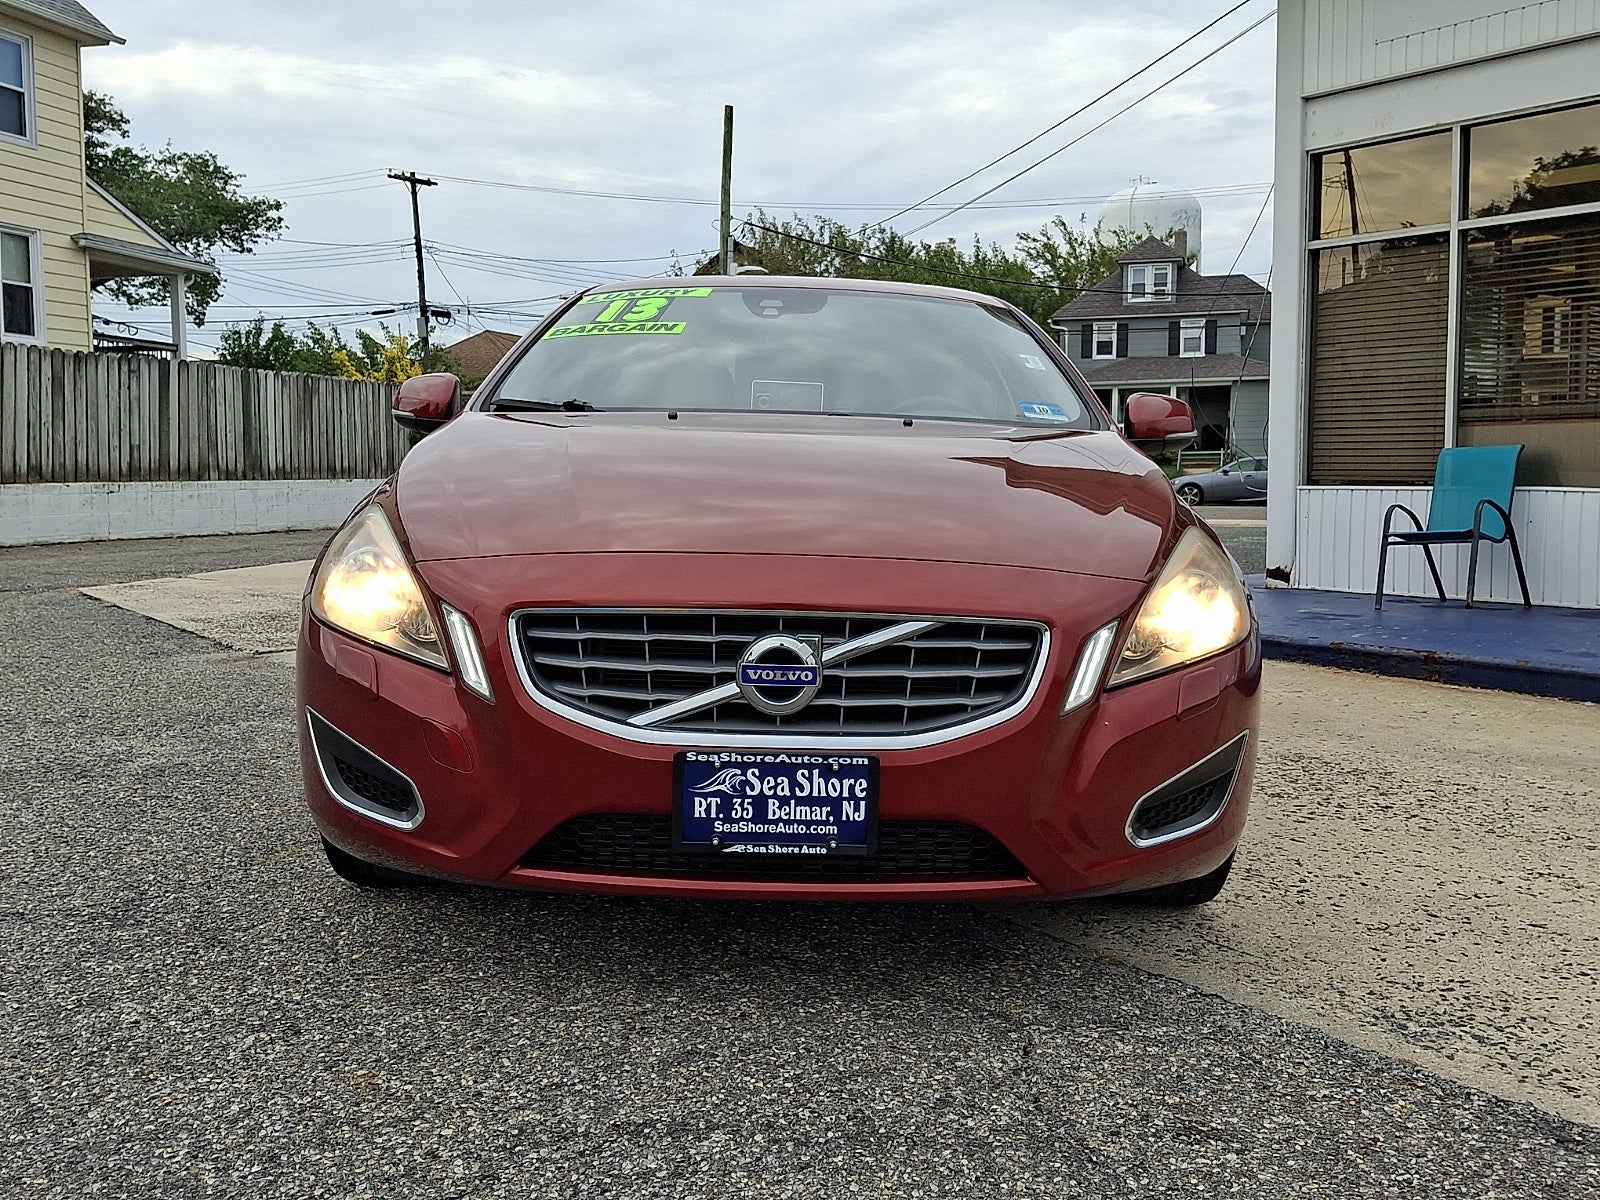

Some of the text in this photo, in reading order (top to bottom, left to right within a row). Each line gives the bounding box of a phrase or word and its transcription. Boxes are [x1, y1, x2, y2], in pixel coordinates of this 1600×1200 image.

[587, 289, 695, 302] LUXURY
[594, 297, 669, 322] 13
[552, 323, 678, 336] BARGAIN
[746, 669, 813, 682] VOLVO
[686, 752, 869, 765] SeaShoreAuto.com
[745, 768, 868, 797] Sea Shore
[693, 797, 866, 822] RT. 35 Belmar, NJ
[714, 821, 838, 835] SeaShoreAuto.com
[746, 845, 827, 854] Sea Shore Auto
